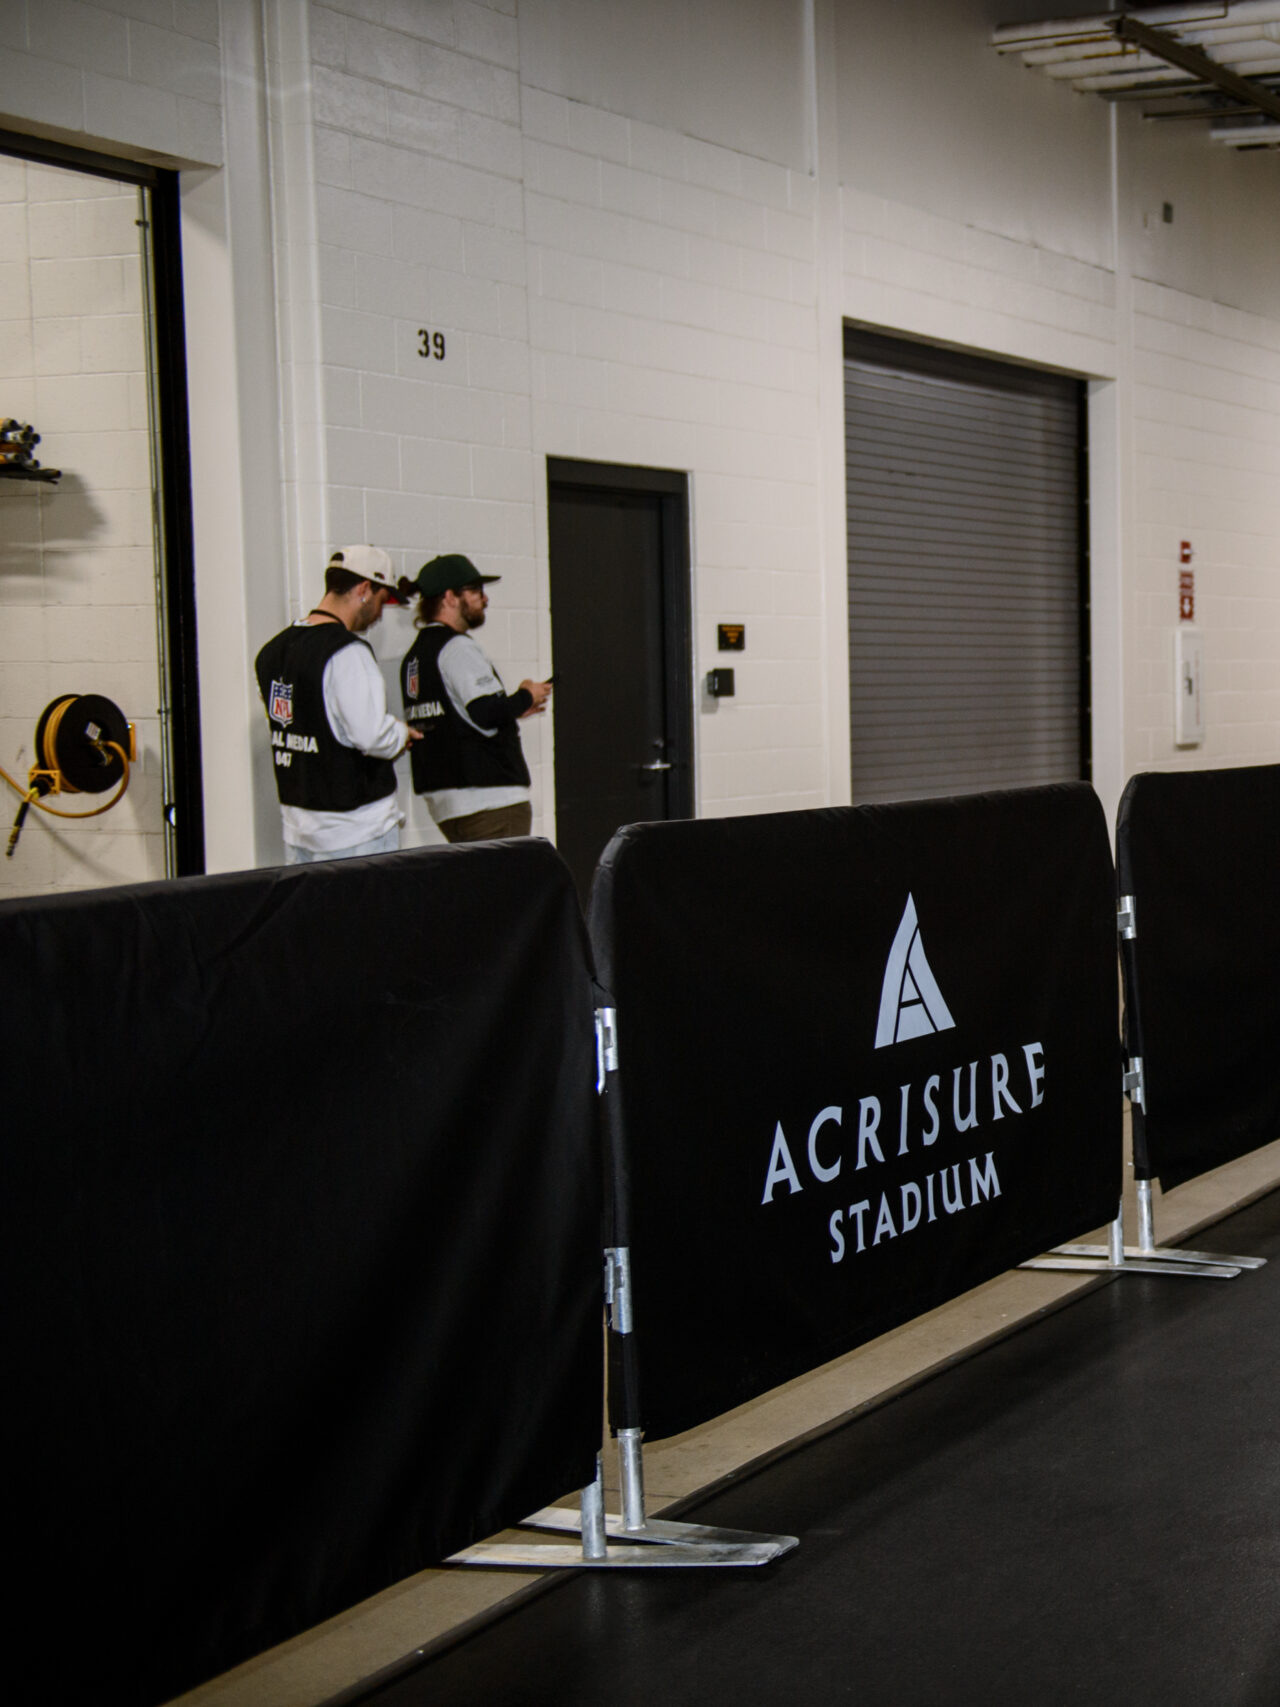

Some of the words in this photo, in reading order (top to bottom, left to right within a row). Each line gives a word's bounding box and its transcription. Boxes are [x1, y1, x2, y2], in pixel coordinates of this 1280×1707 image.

[417, 329, 446, 361] 39
[761, 1042, 1046, 1205] ACRISURE
[829, 1151, 1002, 1263] STADIUM
